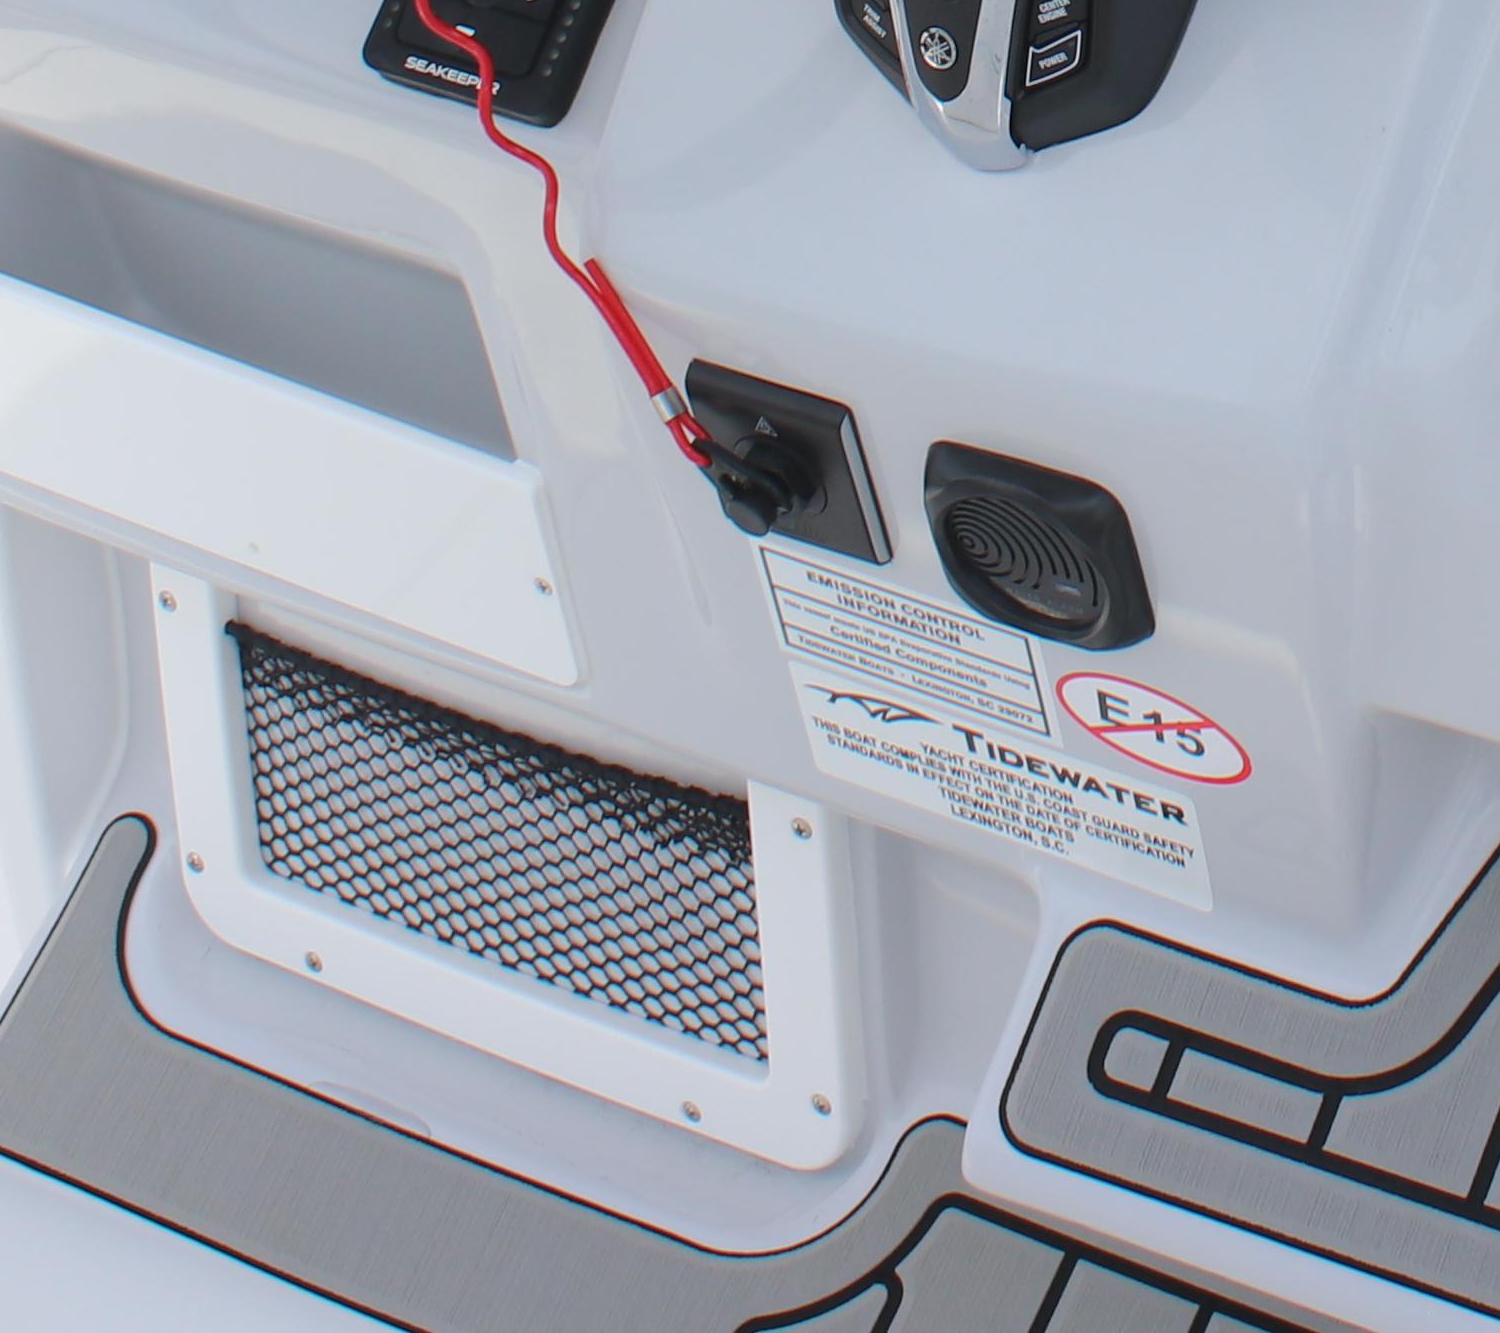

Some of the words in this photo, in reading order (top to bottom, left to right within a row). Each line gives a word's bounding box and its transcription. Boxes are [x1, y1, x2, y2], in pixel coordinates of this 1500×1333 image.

[862, 12, 887, 39] ASSIST
[863, 3, 881, 23] TRIM
[1038, 7, 1068, 24] ENGINE
[1038, 51, 1068, 70] POWER
[806, 570, 897, 610] EMISSION
[900, 601, 985, 641] CONTROL
[837, 593, 962, 646] INFORMATION
[799, 635, 858, 665] TIDEWATER
[859, 656, 895, 677] BOATS
[976, 697, 996, 711] SC
[830, 623, 892, 657] Certified
[895, 645, 988, 689] Components
[859, 621, 877, 634] US
[878, 627, 899, 645] EPA
[954, 655, 1002, 679] Standards
[812, 715, 842, 737] THIS
[843, 725, 878, 750] BOAT
[880, 738, 948, 774] COMPLIES
[949, 763, 984, 787] WITH
[985, 775, 1012, 796] THE
[1013, 784, 1042, 807] U.S.
[1043, 796, 1091, 824] COAST
[1091, 811, 1141, 841] GUARD
[1142, 831, 1196, 860] SAFETY
[827, 734, 905, 772] STANDARDS
[906, 762, 921, 776] IN
[922, 769, 974, 796] EFFECT
[974, 785, 997, 803] ON
[998, 793, 1025, 815] THE
[1025, 803, 1063, 827] DATE
[1063, 815, 1084, 832] OF
[1084, 822, 1188, 869] CERTIFICATION
[920, 740, 967, 767] YACHT
[969, 758, 1075, 805] CERTIFICATION
[951, 724, 1190, 827] TIDEWATER
[938, 786, 1022, 824] TIDEWATER
[1024, 814, 1076, 844] BOATS
[950, 804, 1040, 848] LEXINGTON,
[1041, 836, 1071, 857] S.C.
